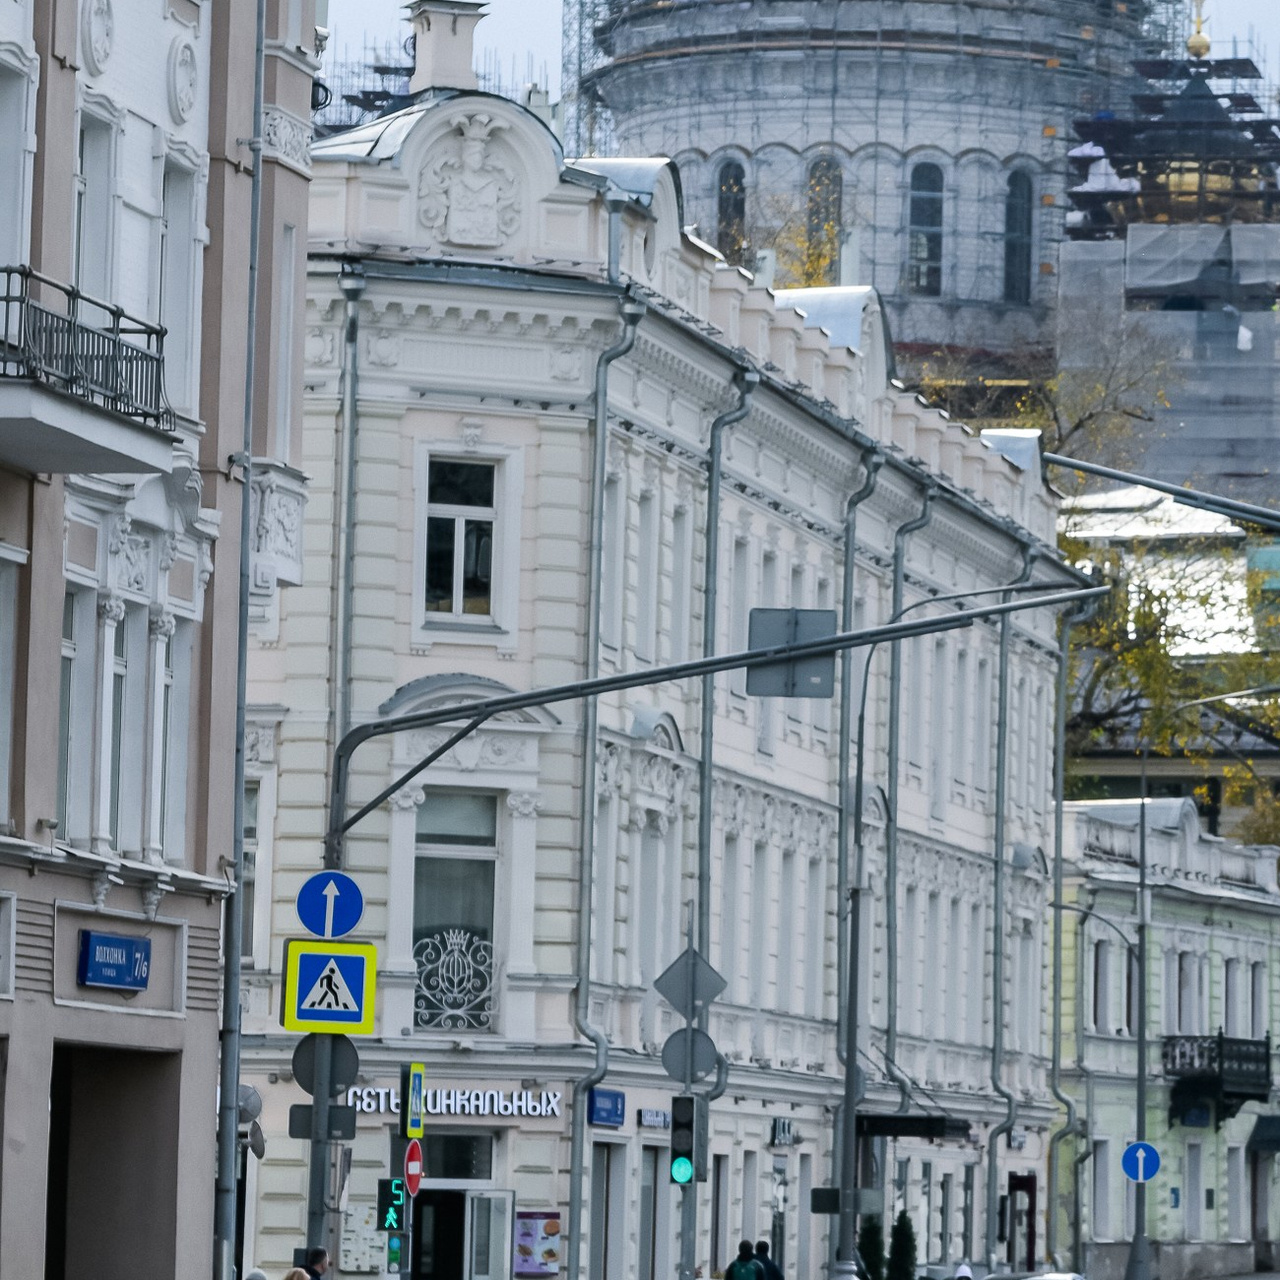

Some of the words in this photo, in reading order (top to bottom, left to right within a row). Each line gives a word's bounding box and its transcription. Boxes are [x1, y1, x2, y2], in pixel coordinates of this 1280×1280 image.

[95, 945, 126, 965] ВОЛХОНКА
[134, 951, 148, 981] 7/6
[391, 1179, 404, 1205] 5
